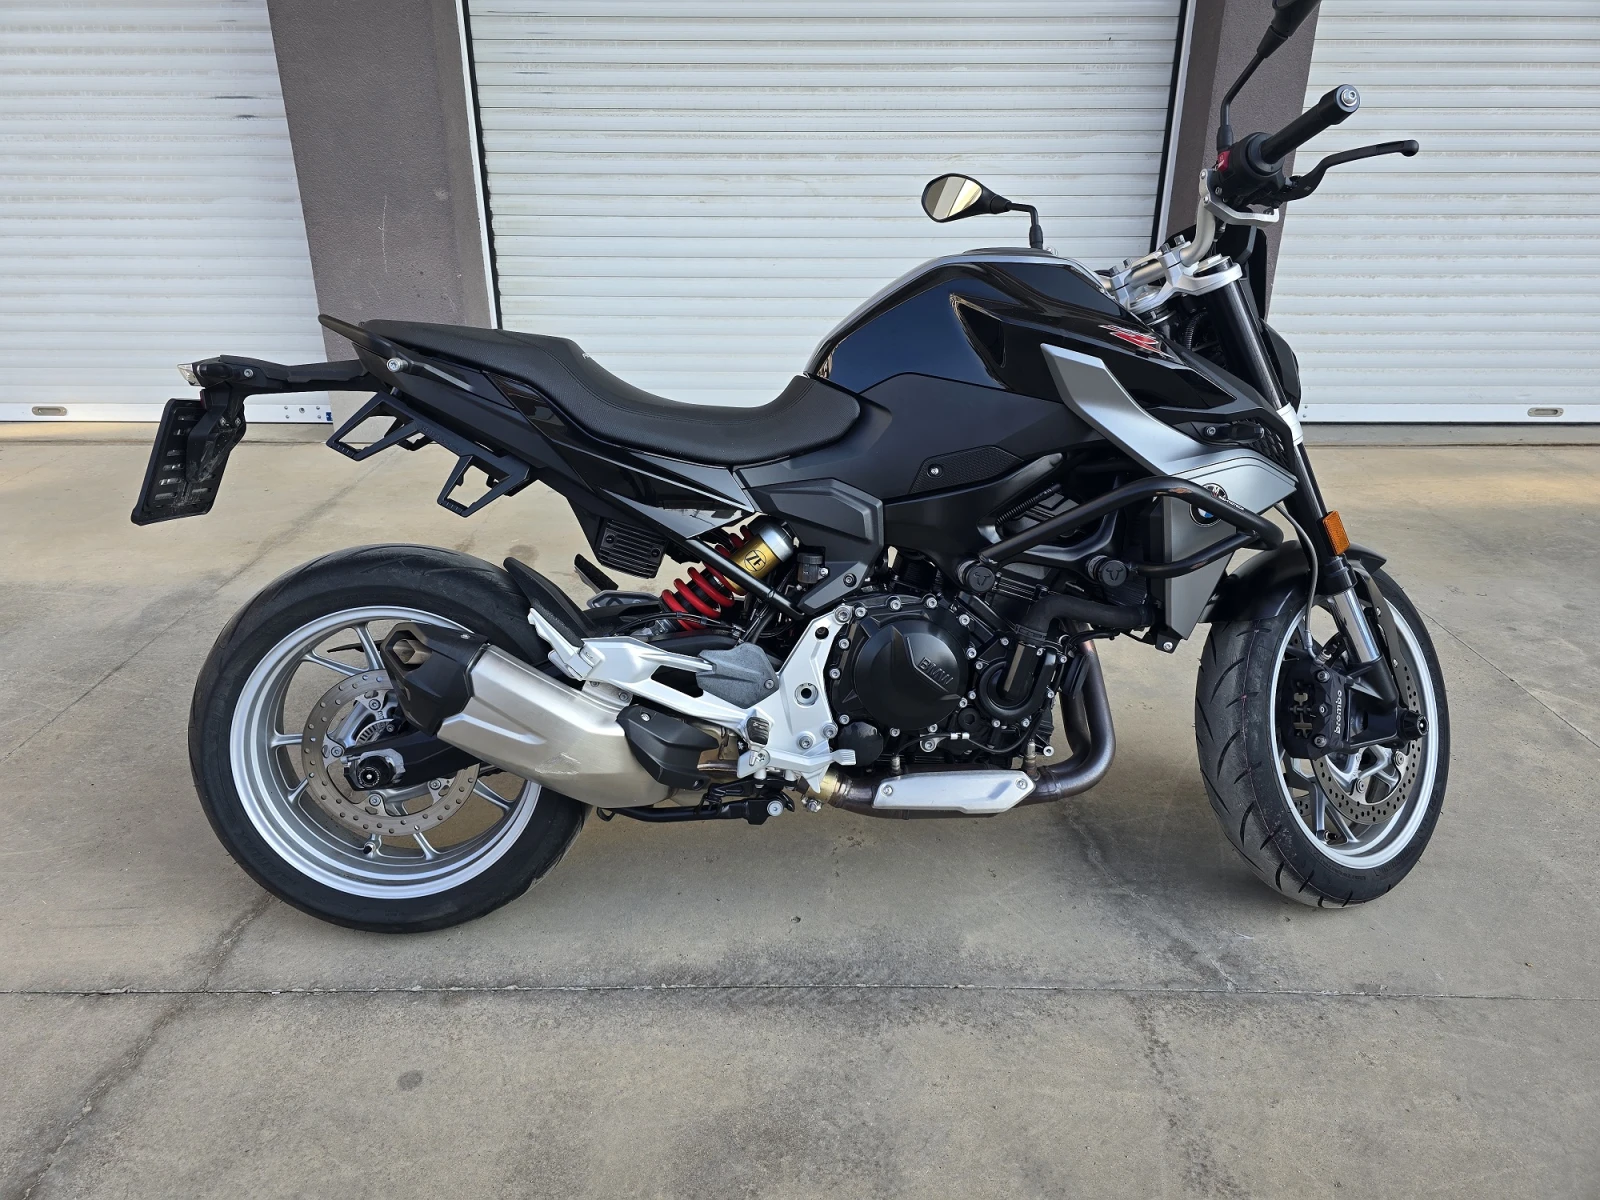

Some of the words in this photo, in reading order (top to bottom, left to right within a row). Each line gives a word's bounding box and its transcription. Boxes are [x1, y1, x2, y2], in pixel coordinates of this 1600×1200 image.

[744, 550, 766, 572] ZF
[918, 657, 953, 685] BMW
[1334, 690, 1342, 734] brembo
